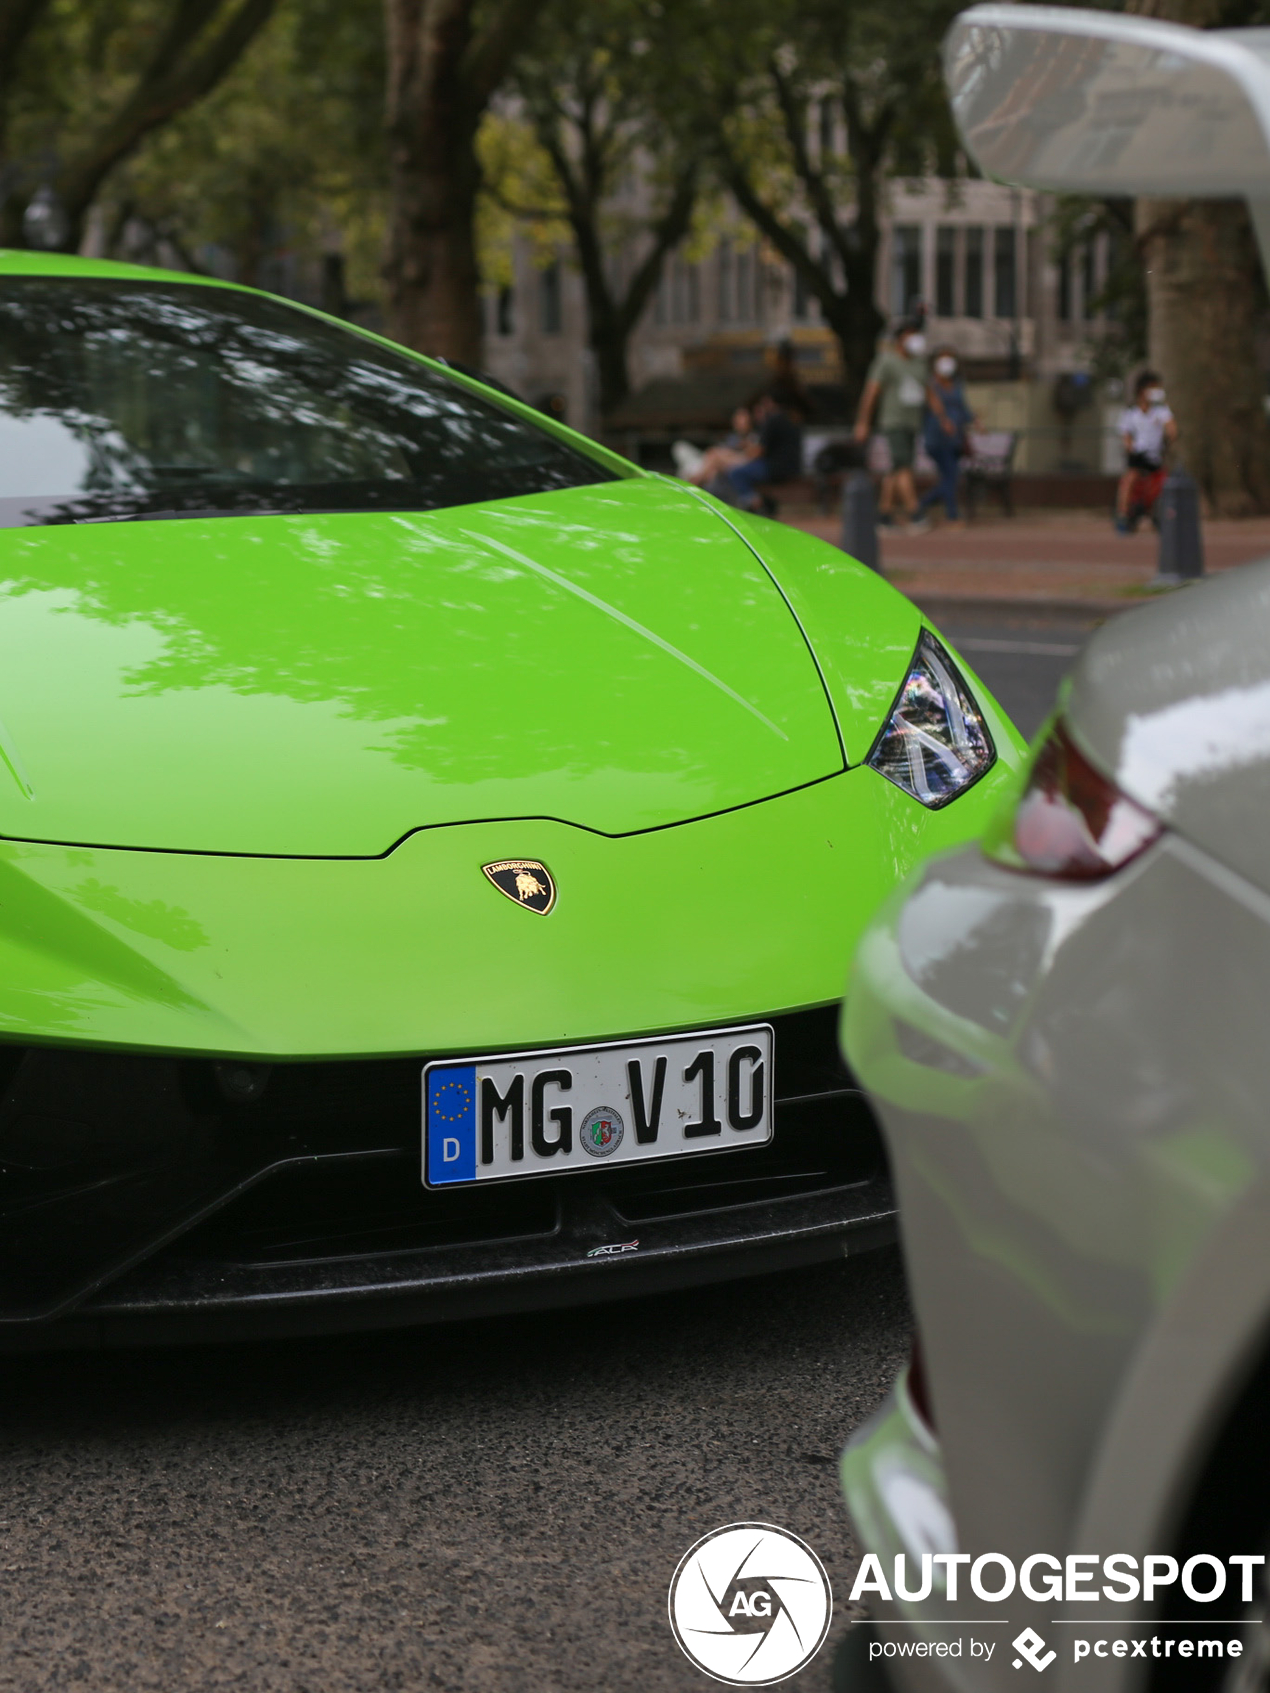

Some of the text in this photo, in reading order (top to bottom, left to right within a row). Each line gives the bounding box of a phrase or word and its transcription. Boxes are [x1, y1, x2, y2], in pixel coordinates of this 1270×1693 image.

[487, 862, 542, 875] LAMBORGHINI
[481, 1068, 573, 1165] MG
[443, 1137, 461, 1162] D
